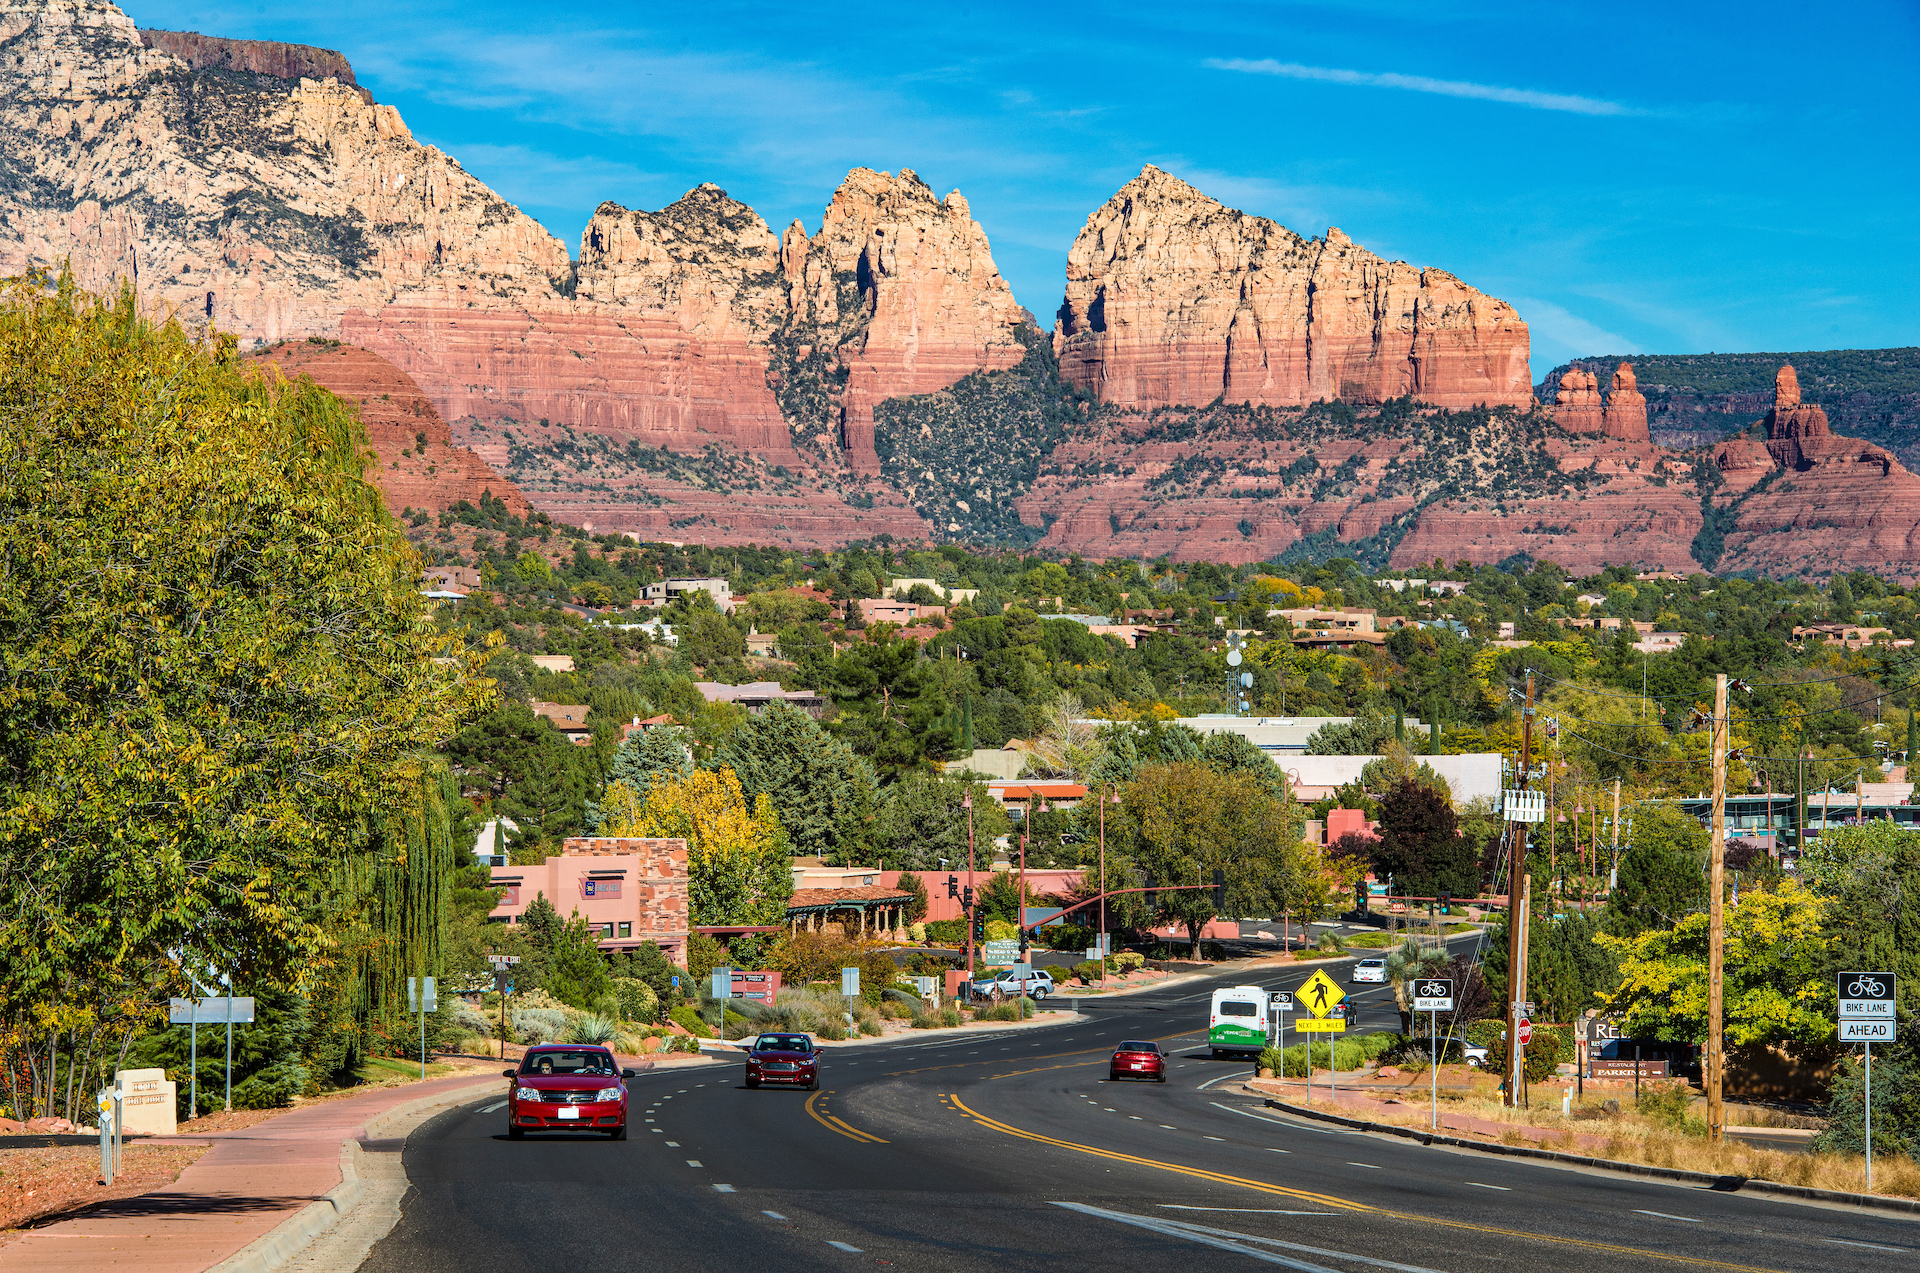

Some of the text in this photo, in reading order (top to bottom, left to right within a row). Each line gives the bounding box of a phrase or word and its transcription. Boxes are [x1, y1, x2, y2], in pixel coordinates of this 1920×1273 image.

[1847, 1004, 1887, 1012] BIKE LANE
[1519, 1026, 1530, 1036] STOP
[1848, 1025, 1886, 1036] AHEAD
